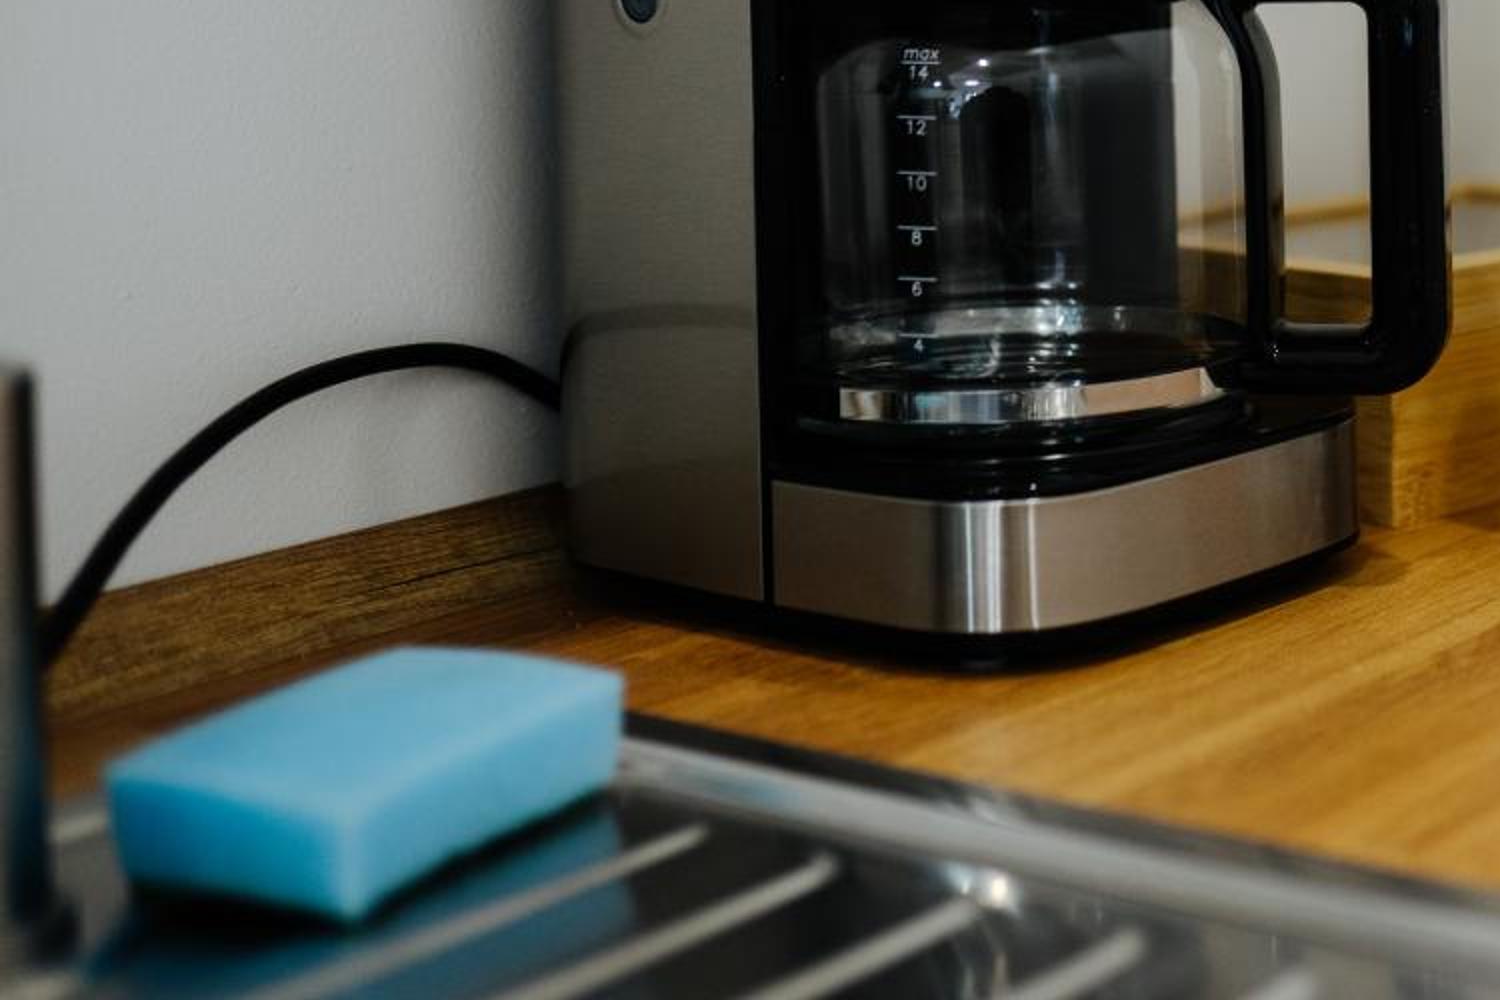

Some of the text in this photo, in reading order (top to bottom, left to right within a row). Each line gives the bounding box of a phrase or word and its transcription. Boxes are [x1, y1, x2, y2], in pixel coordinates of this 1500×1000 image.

[903, 48, 939, 60] max
[910, 66, 929, 80] 14
[907, 120, 926, 136] 12
[907, 176, 927, 191] 10
[911, 231, 923, 246] 8
[911, 282, 923, 297] 6
